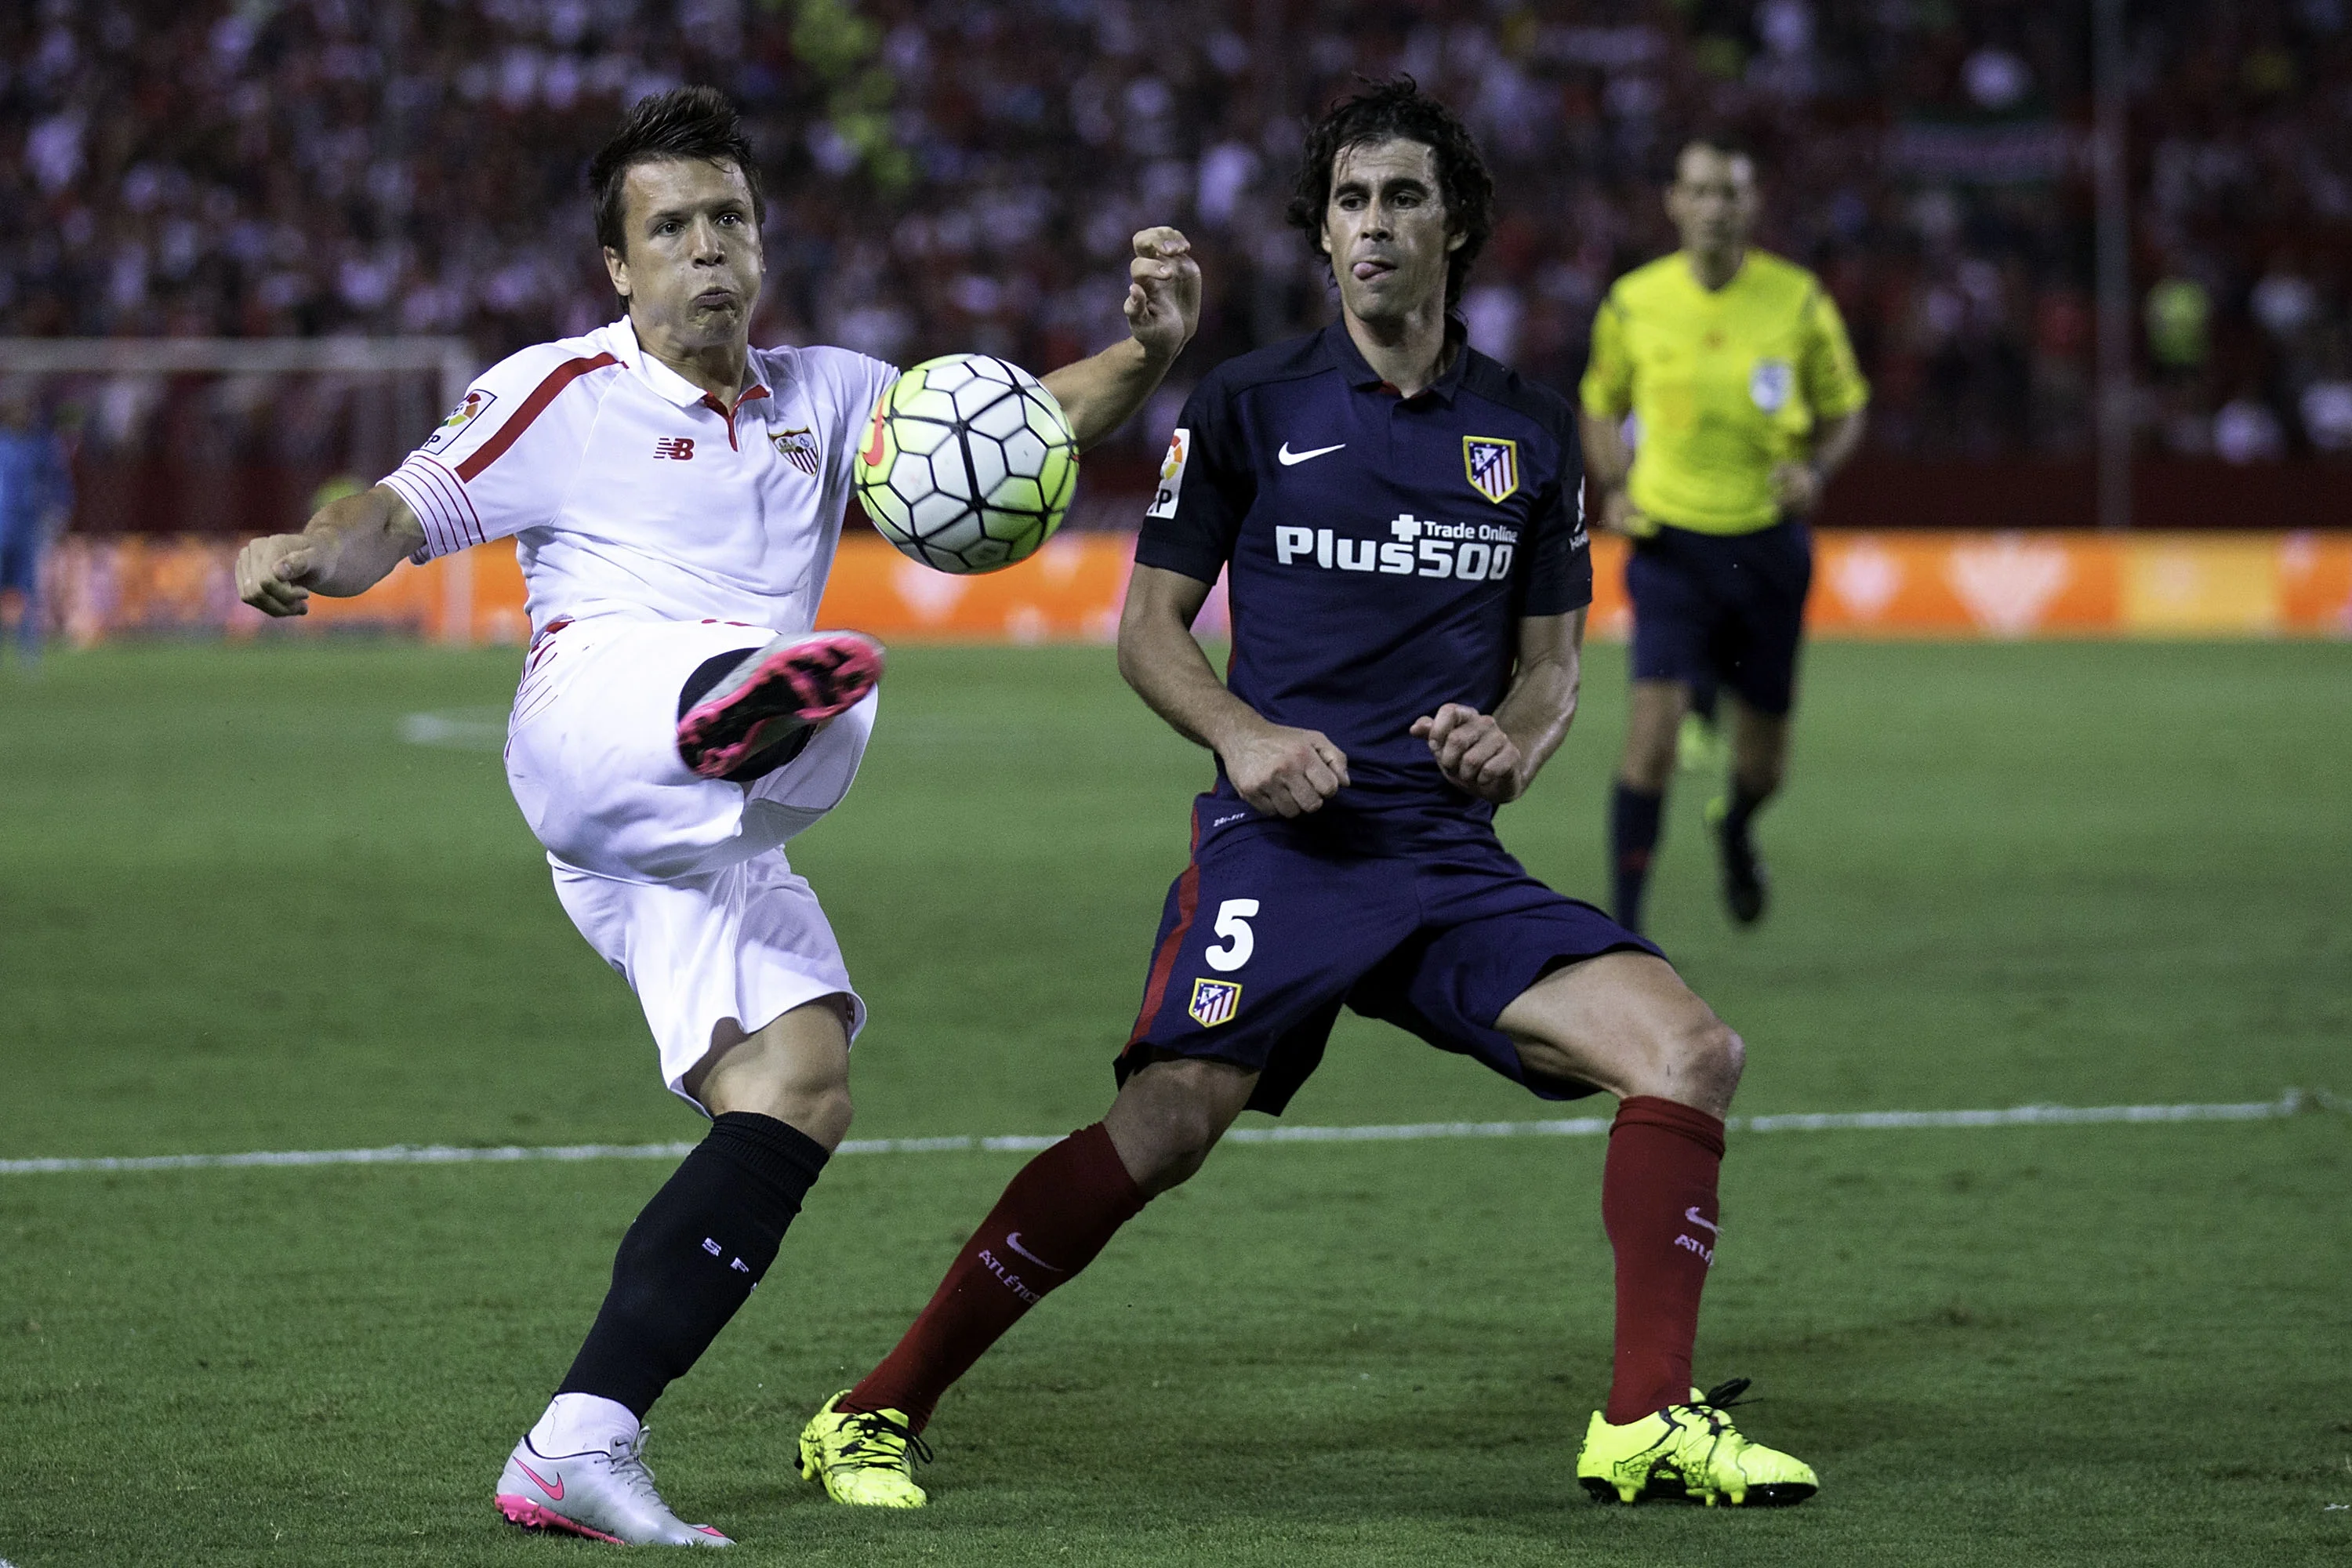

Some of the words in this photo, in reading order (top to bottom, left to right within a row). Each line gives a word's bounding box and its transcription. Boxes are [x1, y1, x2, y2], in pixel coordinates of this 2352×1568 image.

[653, 437, 695, 460] NB
[1423, 520, 1475, 539] Trade
[1479, 524, 1519, 543] Online
[1275, 524, 1514, 580] Plus500
[1205, 898, 1260, 971] 5
